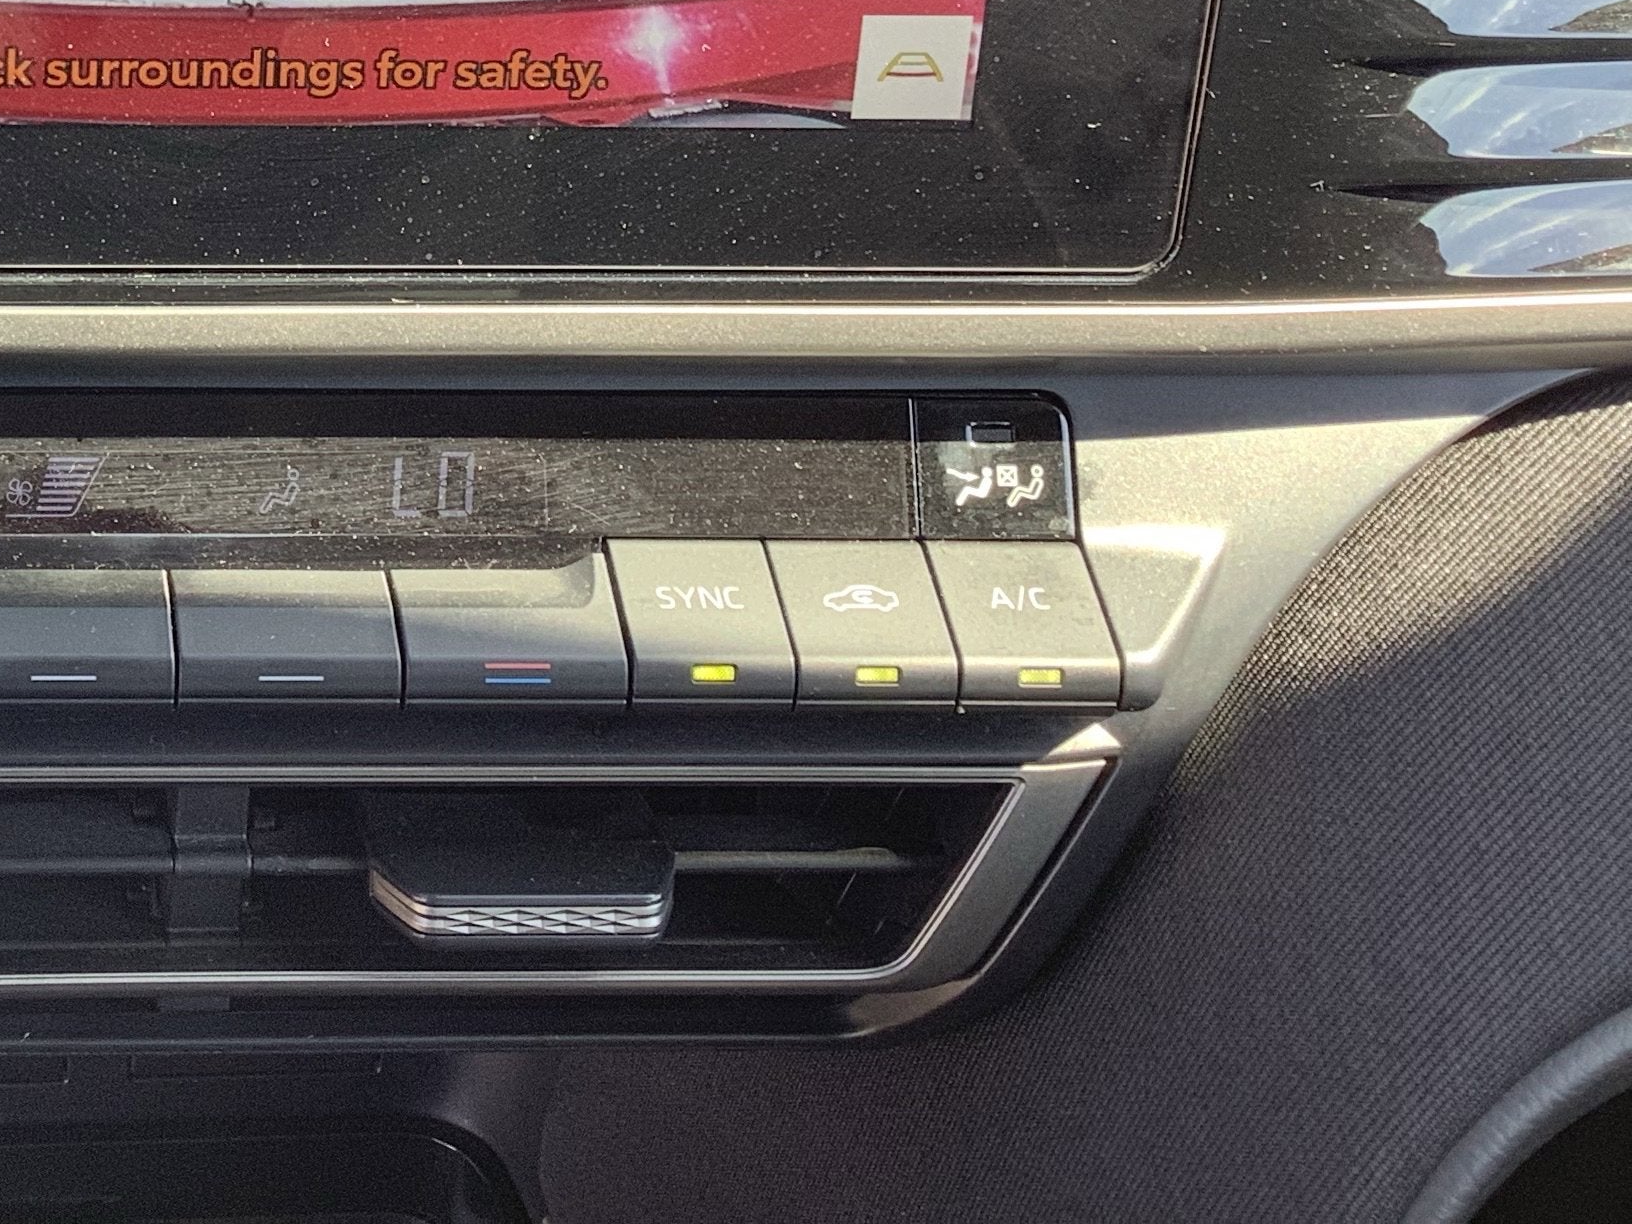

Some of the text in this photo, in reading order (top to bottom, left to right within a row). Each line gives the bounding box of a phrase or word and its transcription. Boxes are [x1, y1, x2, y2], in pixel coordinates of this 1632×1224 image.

[45, 47, 364, 98] surroundings
[374, 48, 446, 88] for
[453, 48, 609, 100] safety.
[655, 585, 745, 610] SYNC
[991, 586, 1051, 611] A/C
